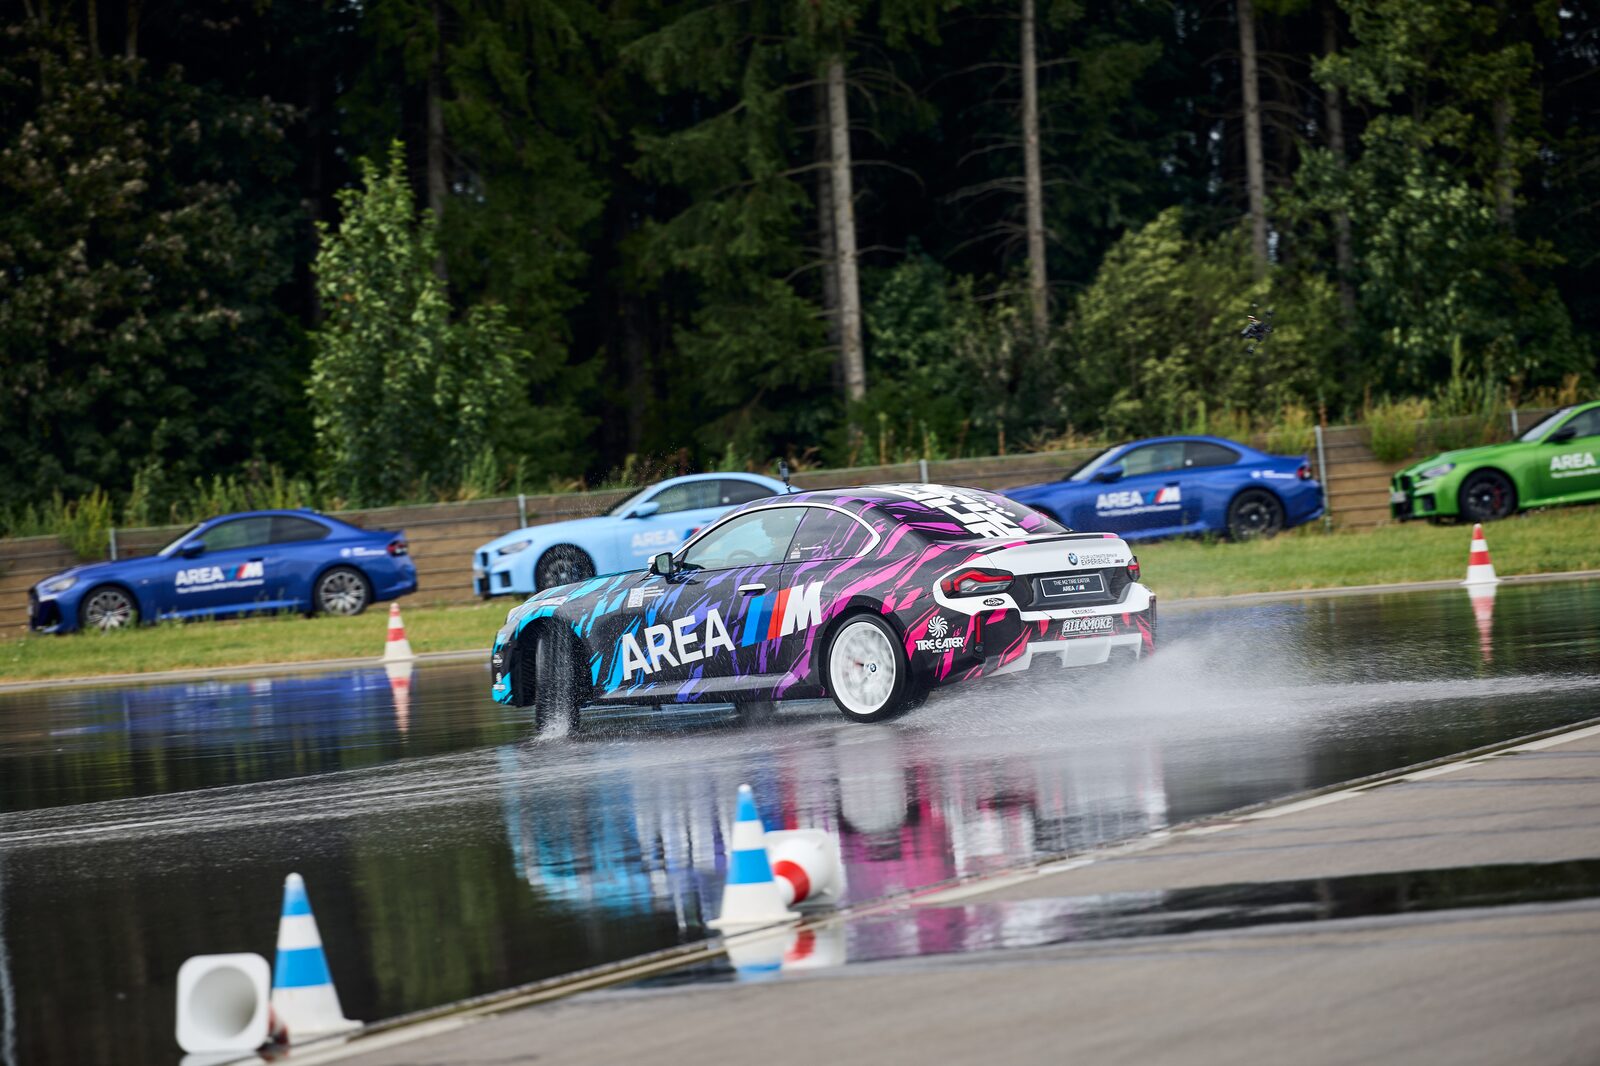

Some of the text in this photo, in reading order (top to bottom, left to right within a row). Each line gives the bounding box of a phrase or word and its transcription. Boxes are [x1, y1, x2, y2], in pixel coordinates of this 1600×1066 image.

[1550, 452, 1597, 471] AREA
[1096, 490, 1144, 509] AREA
[632, 528, 678, 548] AREA
[1081, 557, 1111, 566] EXPERIENCE
[175, 566, 225, 586] AREA
[622, 608, 735, 681] AREA
[916, 636, 964, 651] TIRE EATER
